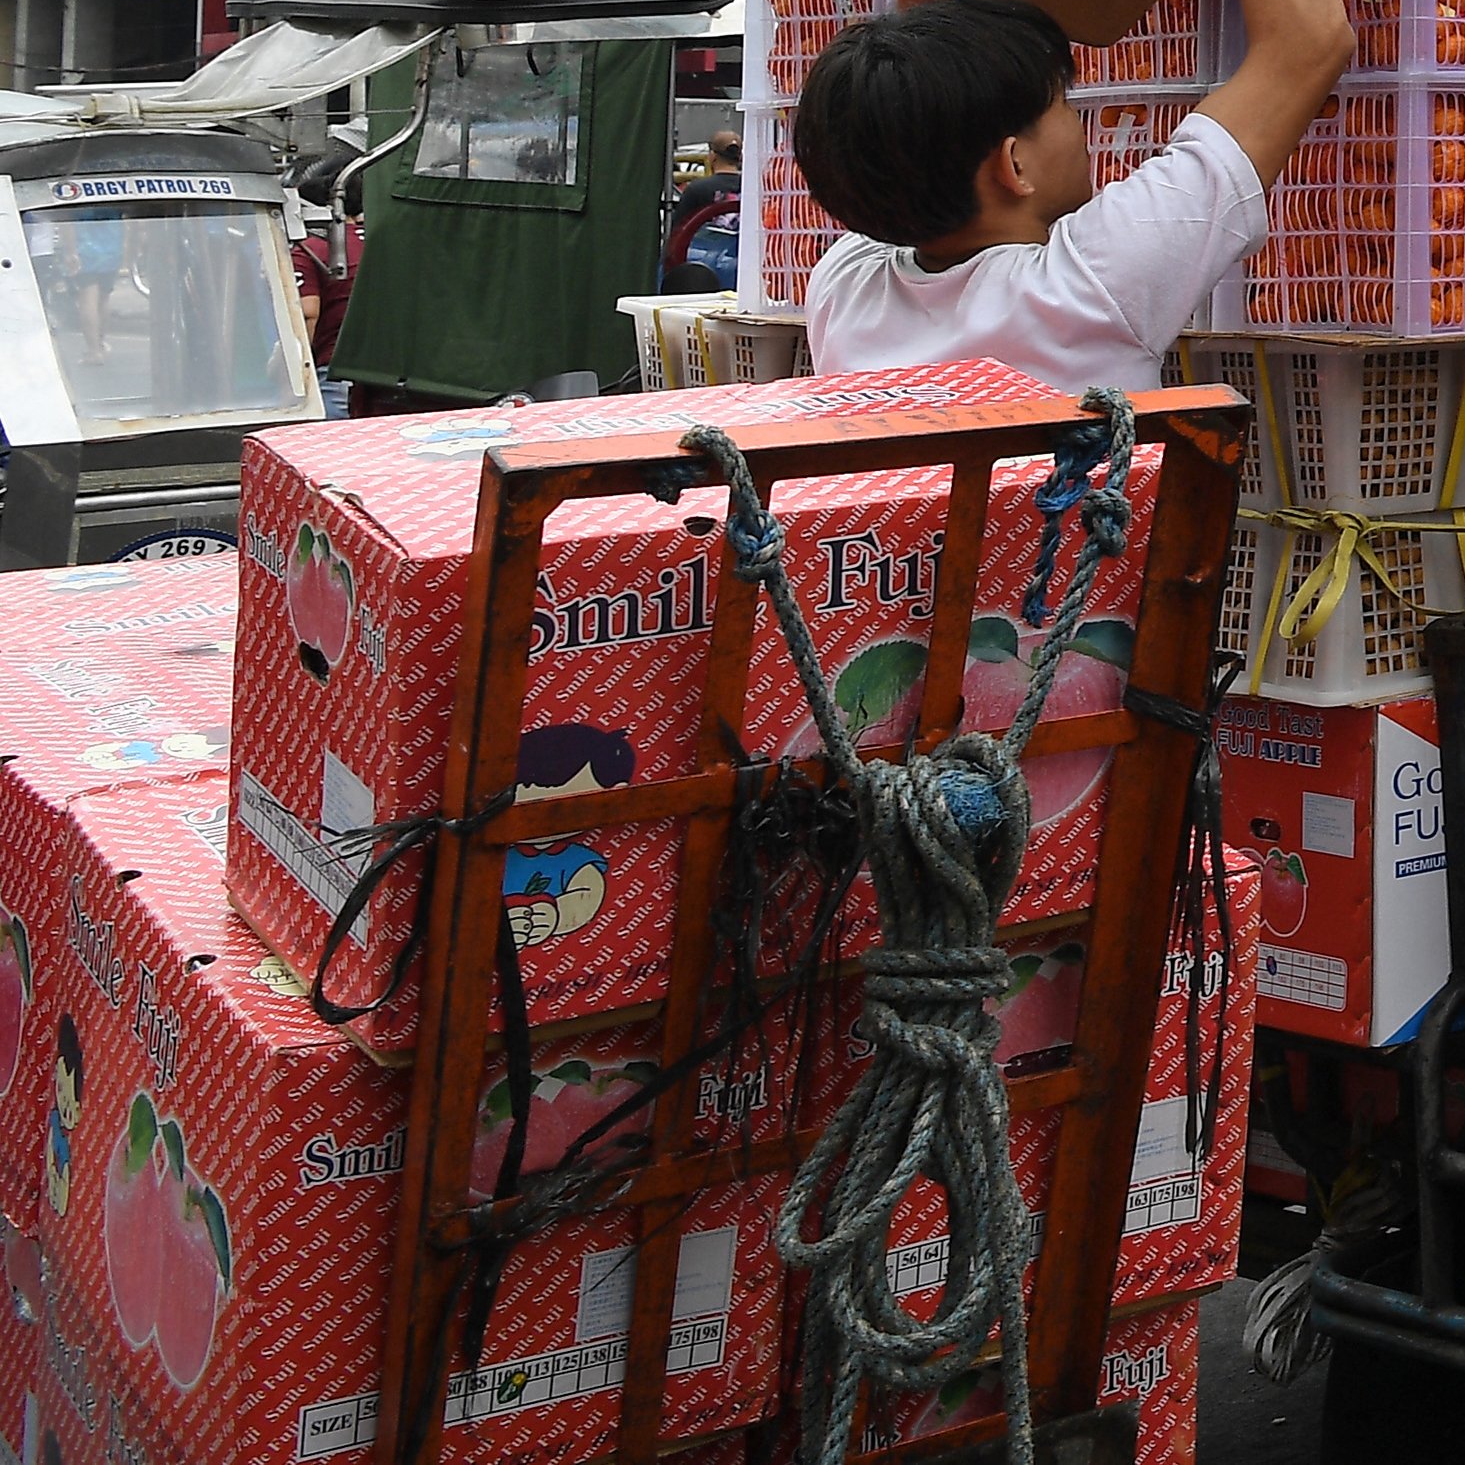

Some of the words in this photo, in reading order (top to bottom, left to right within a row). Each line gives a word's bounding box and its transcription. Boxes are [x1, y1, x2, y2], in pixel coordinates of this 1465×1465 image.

[82, 180, 133, 196] BRGY.
[137, 180, 196, 194] PATROL
[200, 180, 232, 194] 269
[161, 539, 205, 558] 269
[247, 511, 286, 581] Smile
[359, 604, 387, 680] Fuji
[529, 553, 716, 666] Smil
[815, 528, 946, 618] Fuj
[1216, 699, 1270, 731] Good
[1277, 704, 1324, 738] Tast
[1216, 728, 1254, 758] FUJI
[1259, 738, 1321, 768] APPLE
[70, 873, 126, 1008] Smile
[134, 960, 182, 1091] Fuji
[300, 1129, 404, 1188] Smil
[1129, 1191, 1148, 1209] 163
[1152, 1187, 1171, 1204] 175
[1175, 1182, 1195, 1200] 198
[902, 1251, 917, 1265] 56
[924, 1246, 938, 1259] 64
[555, 1354, 578, 1371] 125
[584, 1348, 607, 1366] 138
[696, 1325, 718, 1342] 198
[1102, 1346, 1170, 1399] Fuji
[310, 1411, 353, 1438] SIZE
